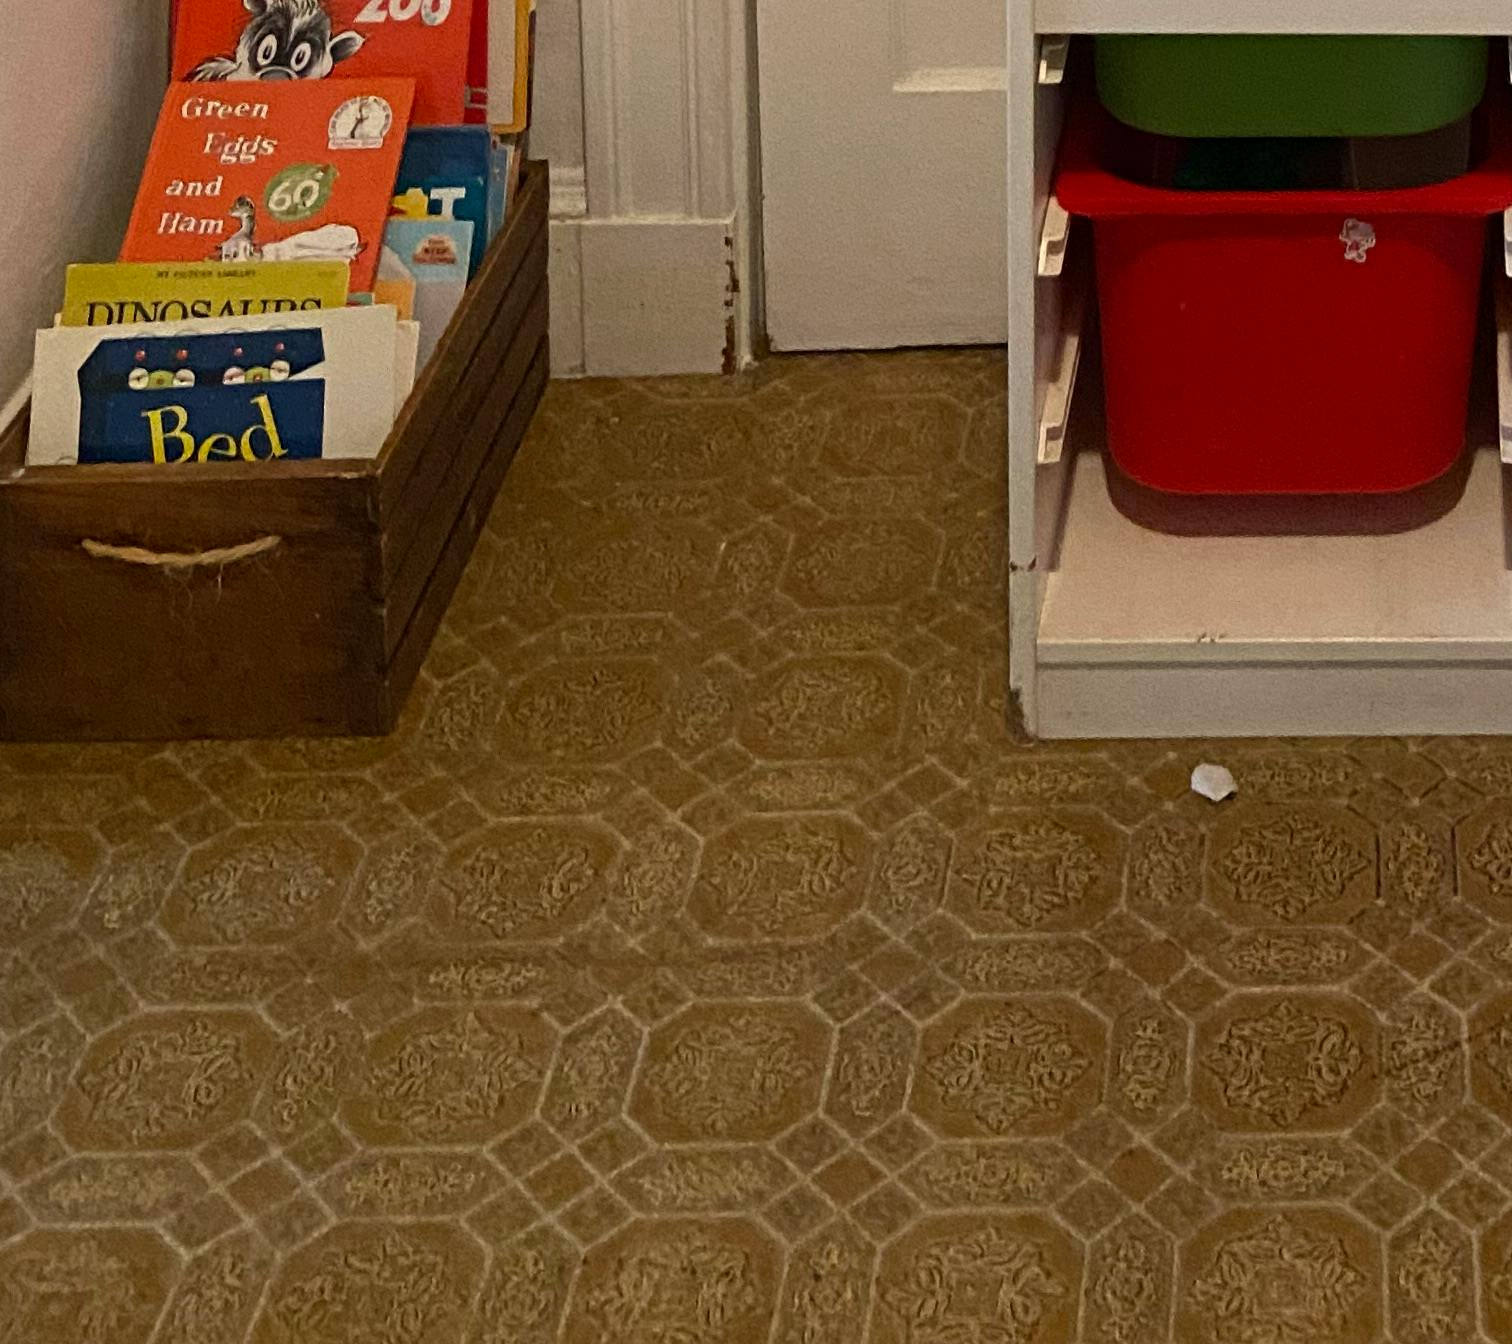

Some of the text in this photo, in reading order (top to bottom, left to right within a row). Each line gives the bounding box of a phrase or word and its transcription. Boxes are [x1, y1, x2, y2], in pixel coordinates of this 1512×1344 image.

[181, 97, 269, 120] Green
[203, 132, 278, 165] Eggs
[165, 175, 223, 197] and
[157, 212, 224, 235] Ham
[140, 393, 288, 464] Bed
